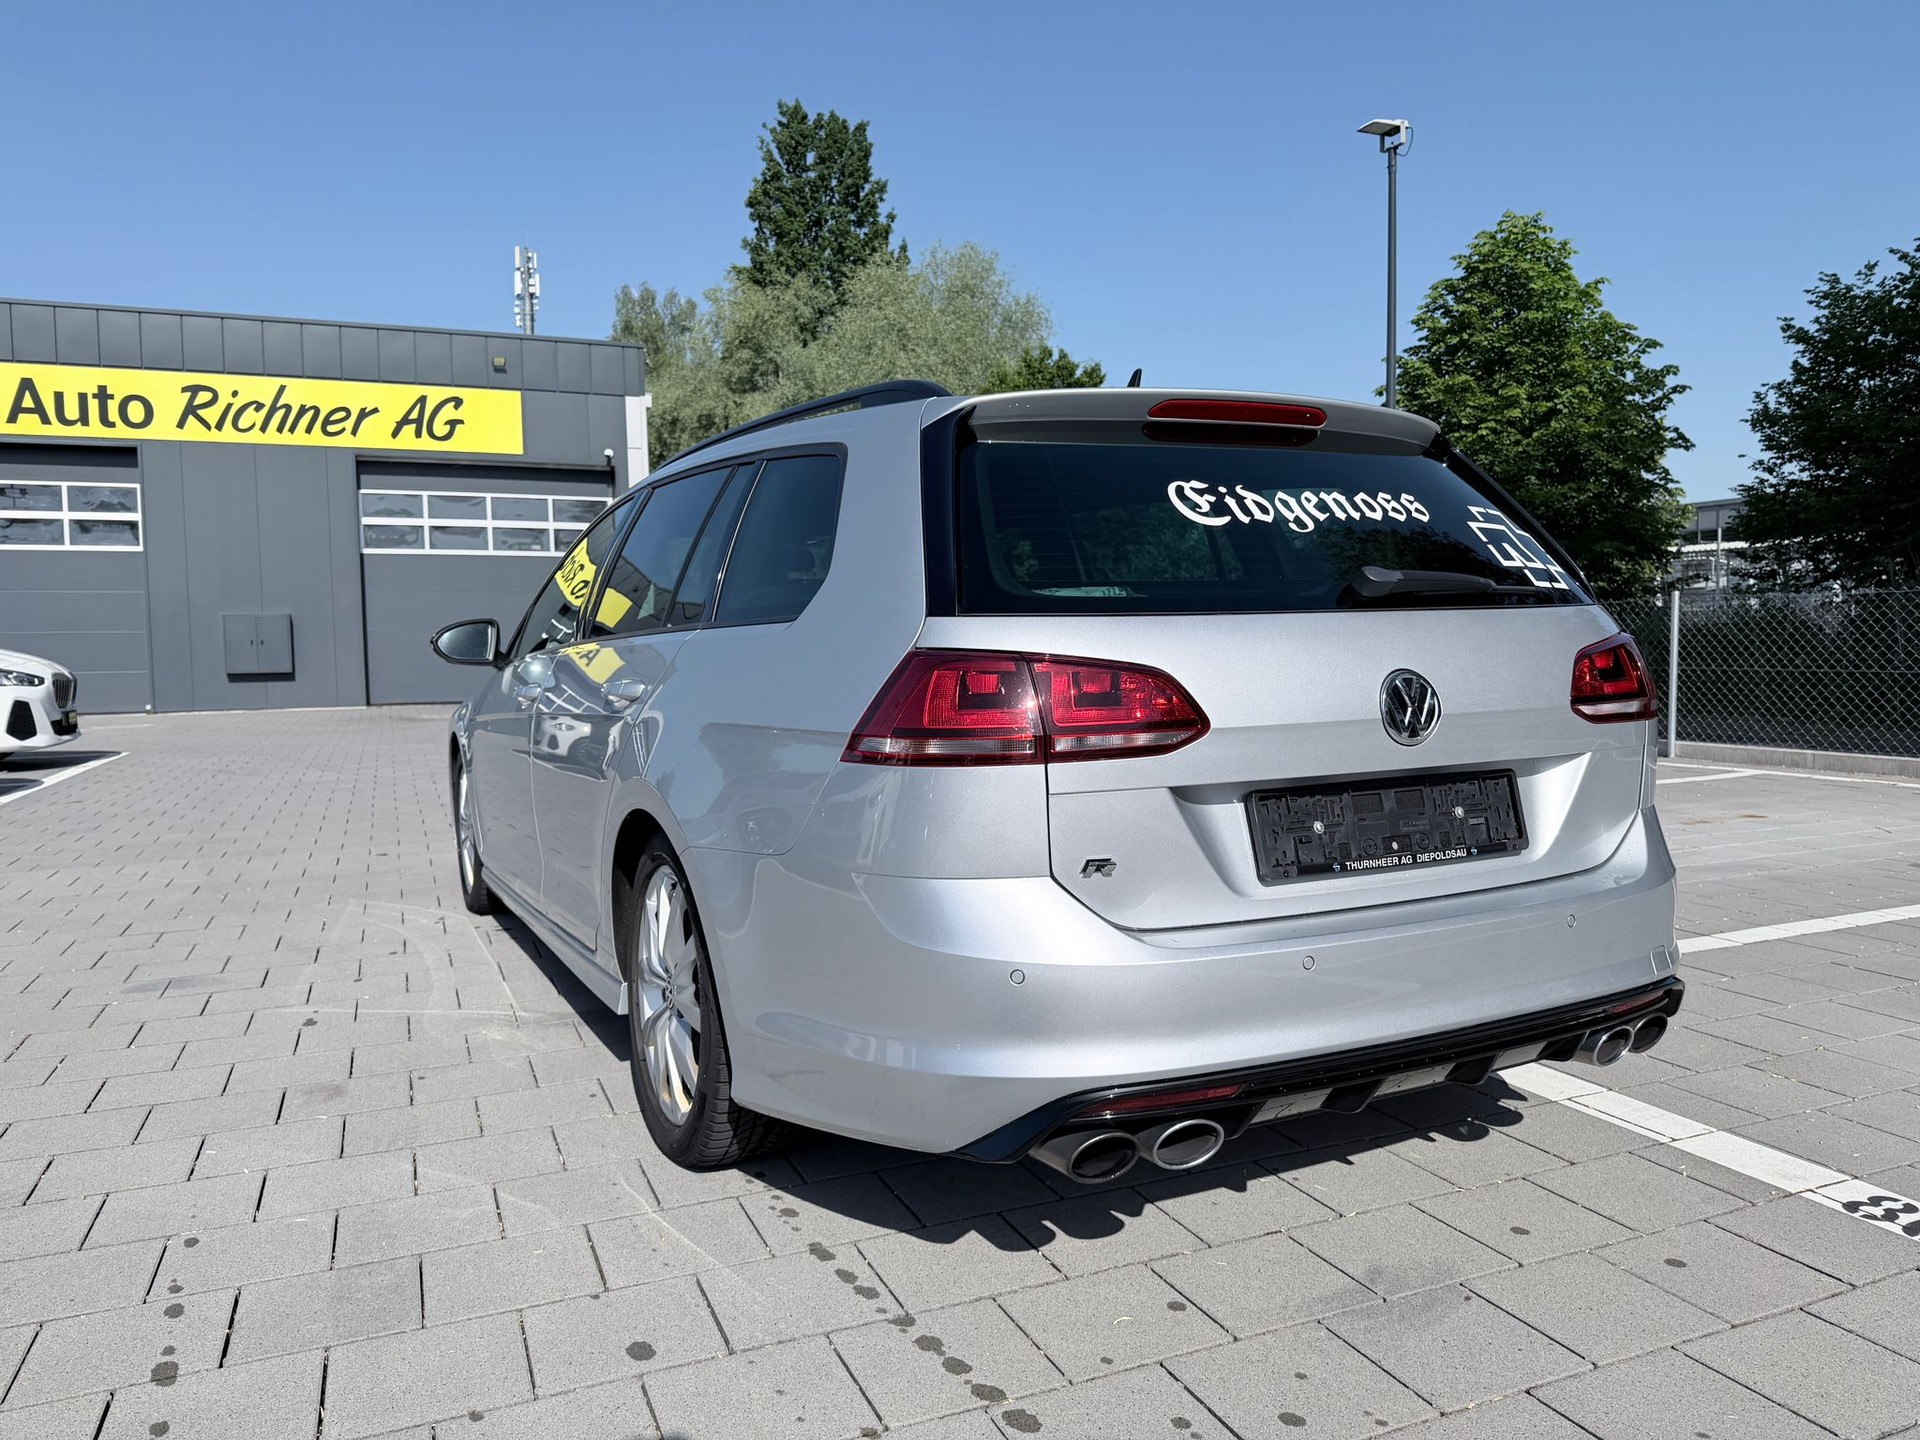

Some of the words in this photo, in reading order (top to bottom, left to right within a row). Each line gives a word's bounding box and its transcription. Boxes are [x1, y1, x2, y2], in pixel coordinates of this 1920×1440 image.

[5, 377, 154, 430] Auto
[175, 384, 380, 437] Richner
[390, 394, 465, 442] AG
[1167, 479, 1430, 533] Eidgenoss
[1382, 671, 1441, 743] VW
[1080, 857, 1117, 879] R
[1345, 857, 1399, 871] THURNHEER
[1400, 855, 1413, 865] AG
[1416, 848, 1467, 863] DIEPOLDSAU
